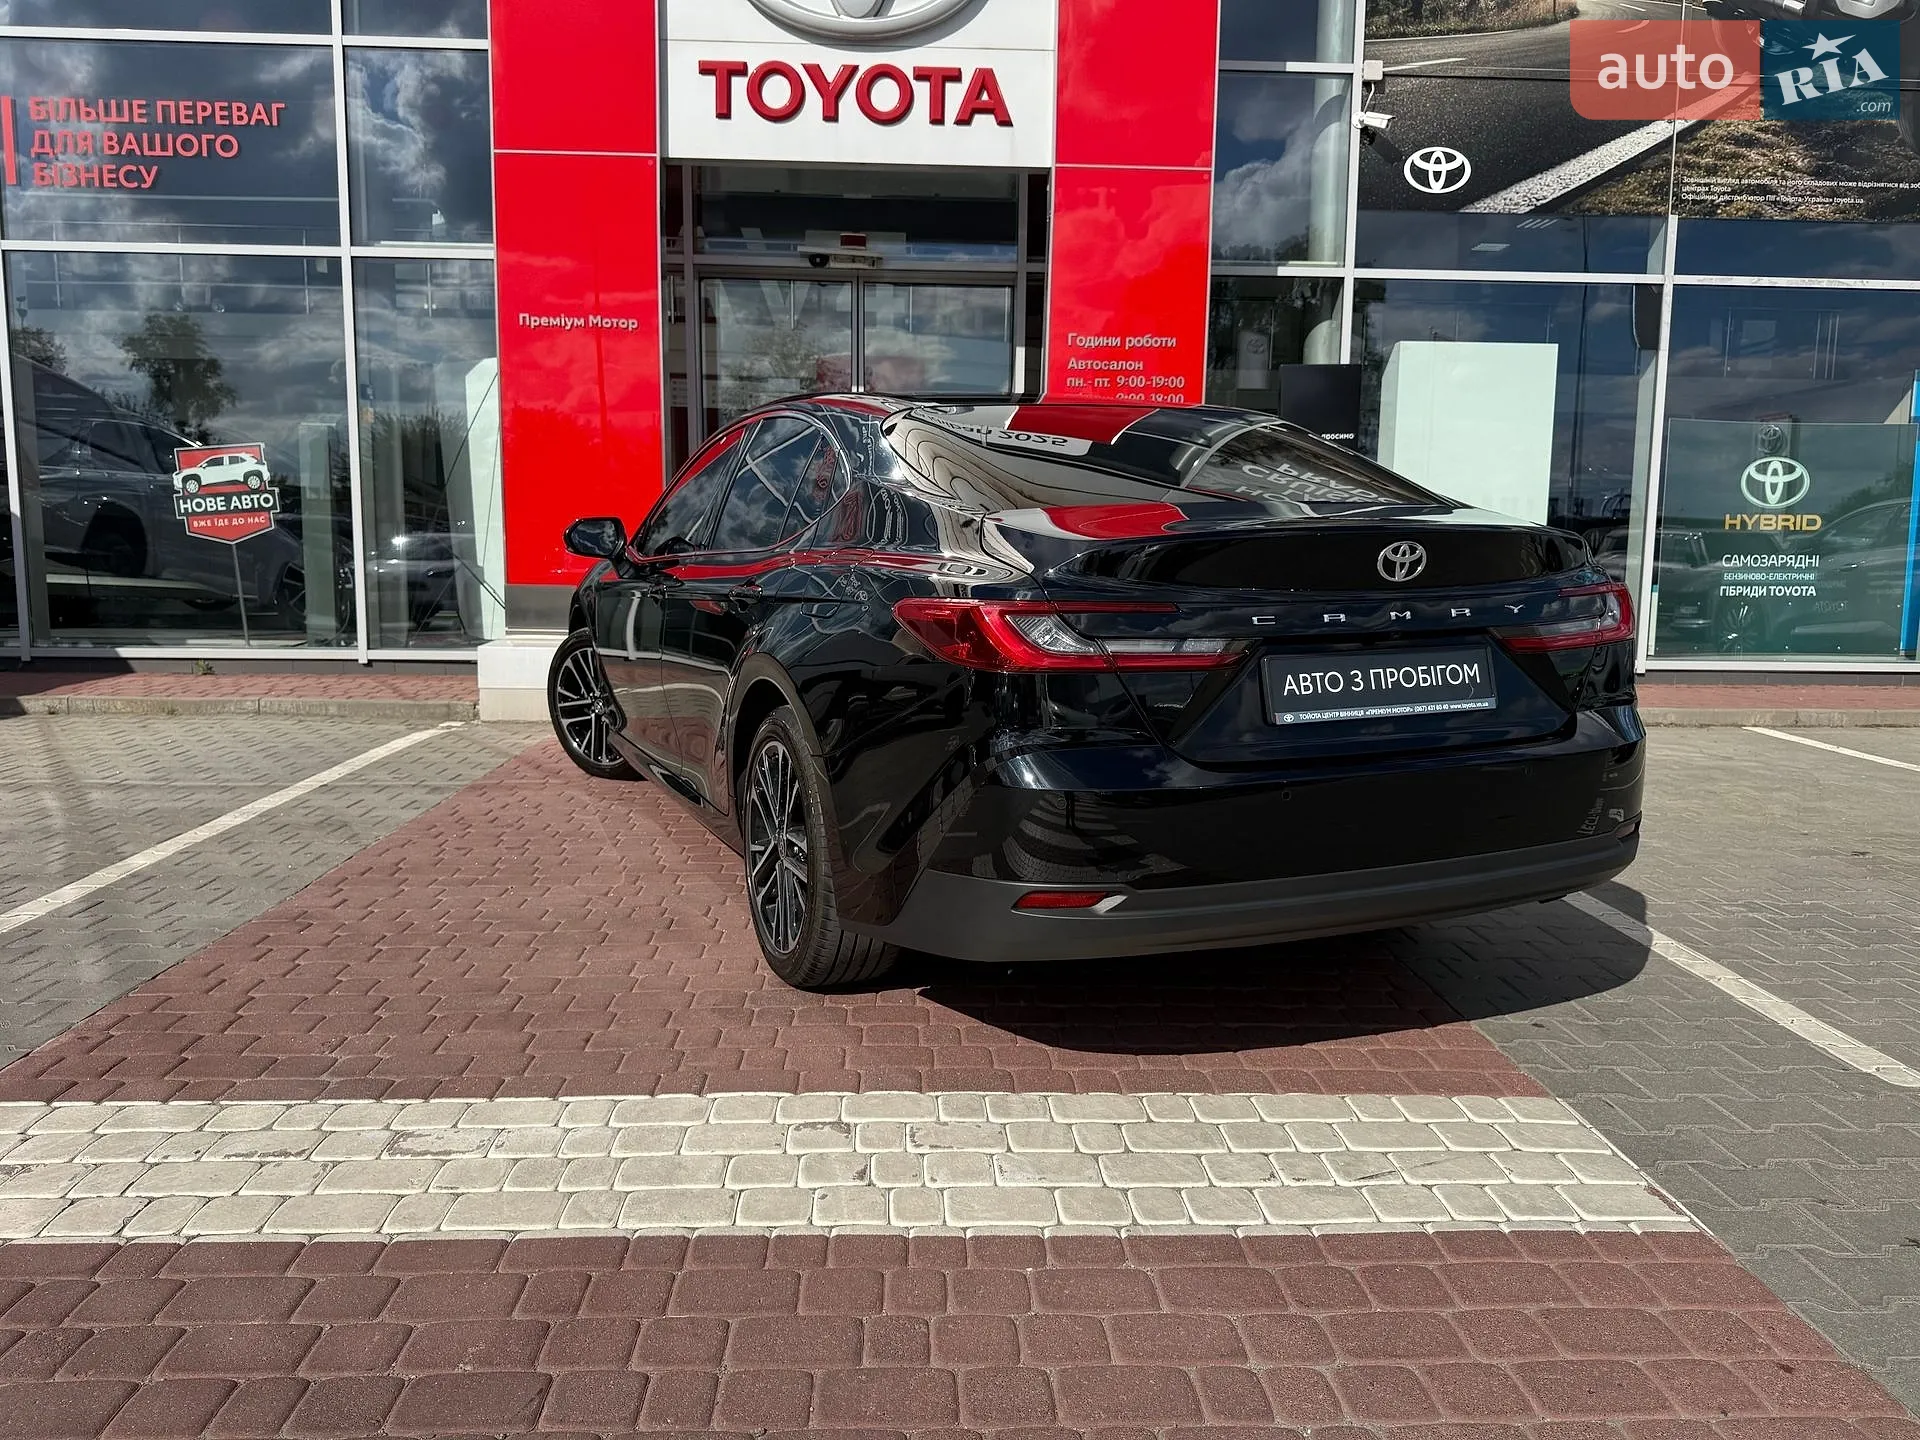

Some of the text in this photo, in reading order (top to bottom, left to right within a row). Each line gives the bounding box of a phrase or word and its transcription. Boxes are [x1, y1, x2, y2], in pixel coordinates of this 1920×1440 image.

[698, 60, 1014, 127] TOYOTA
[29, 96, 286, 127] БІЛЬШЕ ПЕРЕВАГ
[30, 130, 240, 158] ДЛЯ ВАШОГО
[33, 162, 159, 189] БІЗНЕСУ
[519, 313, 638, 331] Преміум Мотор
[1067, 333, 1177, 350] Години роботи
[1067, 357, 1144, 371] Автосалон
[1116, 376, 1185, 388] 9:00-19:00
[179, 493, 274, 513] НОВЕ АВТО
[193, 515, 266, 528] ВЖЕ ЇДЕ ДО НАС
[1724, 513, 1823, 532] HYBRID
[1722, 554, 1820, 570] САМОЗАРЯДНІ
[1723, 572, 1816, 581] БЕНЗИНОВО-ЕЛЕКТРИЧНІ
[1719, 586, 1817, 598] ГІБРИДИ TOYOTA
[1251, 604, 1526, 625] CAMRY
[1283, 663, 1481, 696] АВТО З ПРОБІГОМ
